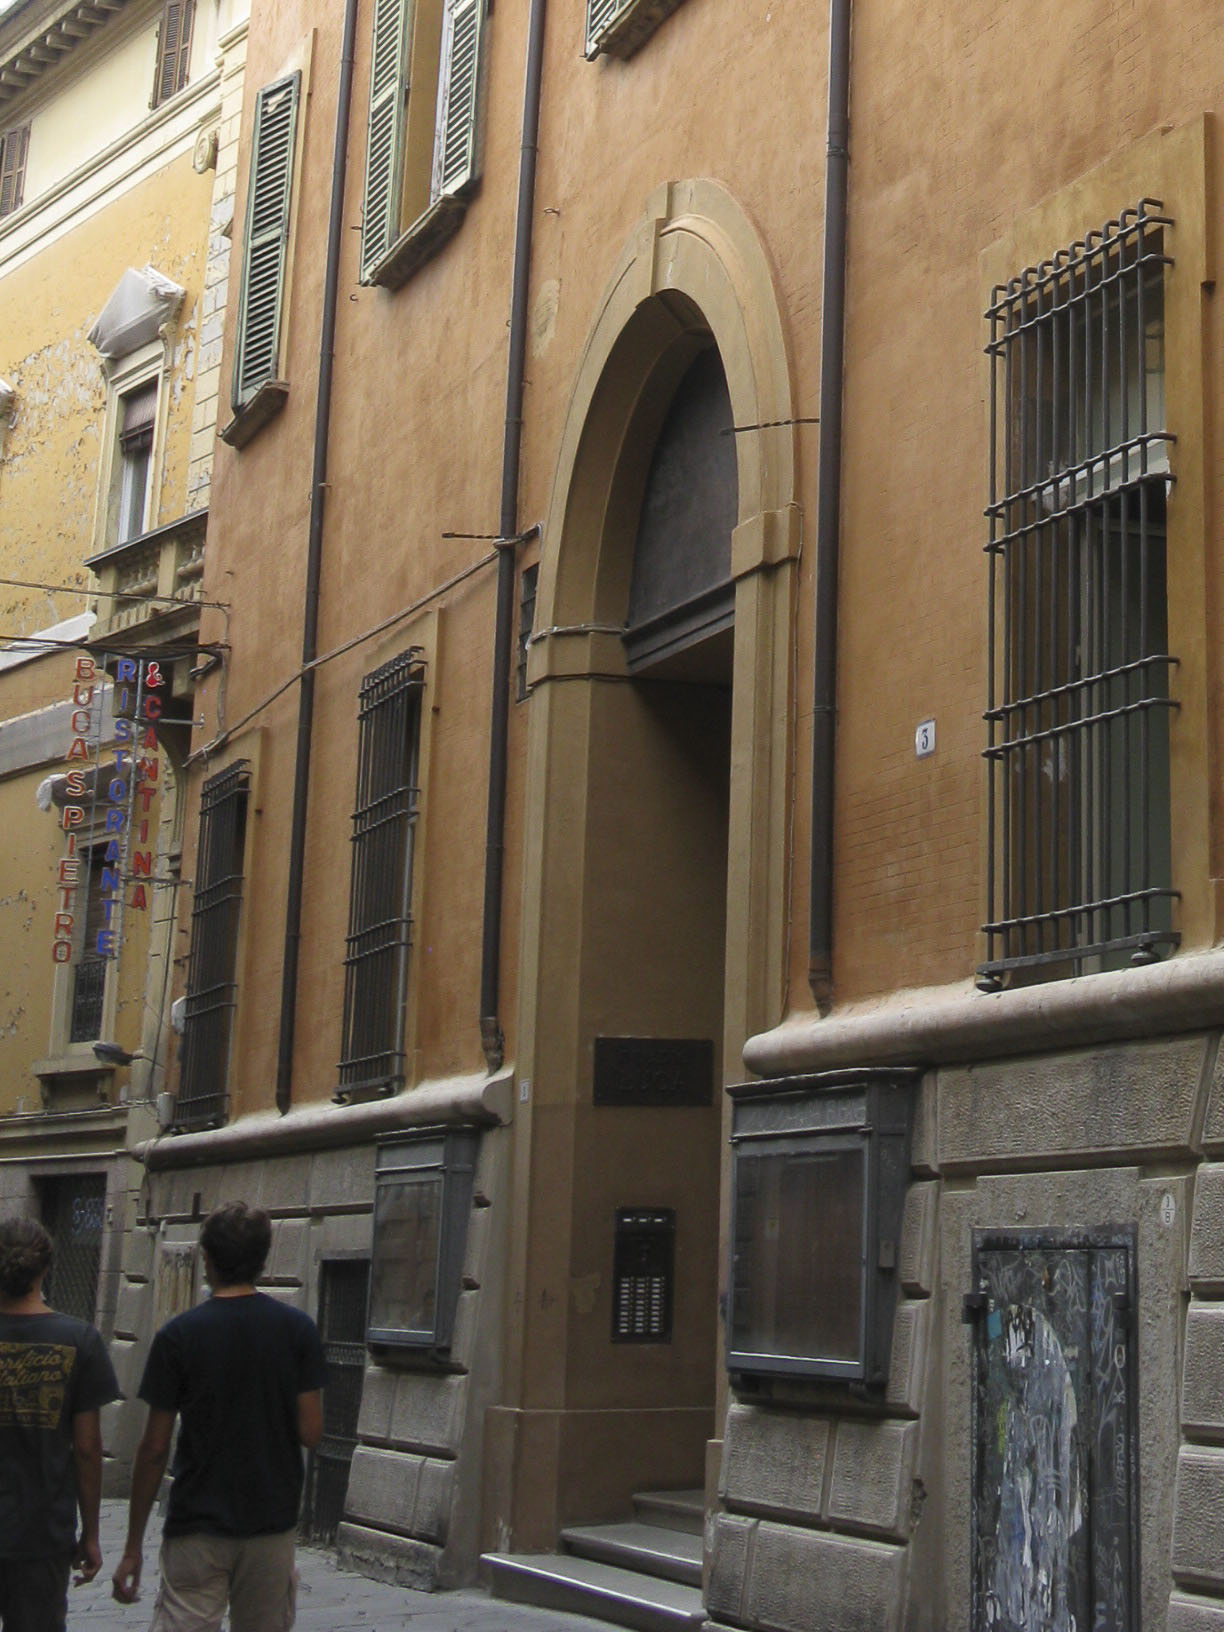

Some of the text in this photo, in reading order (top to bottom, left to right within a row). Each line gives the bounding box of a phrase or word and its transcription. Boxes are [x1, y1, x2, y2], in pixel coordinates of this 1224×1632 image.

[66, 656, 96, 761] BUCA
[96, 658, 137, 954] RISTORANTE
[131, 661, 165, 911] & CANTINA
[52, 805, 85, 964] PIETRO
